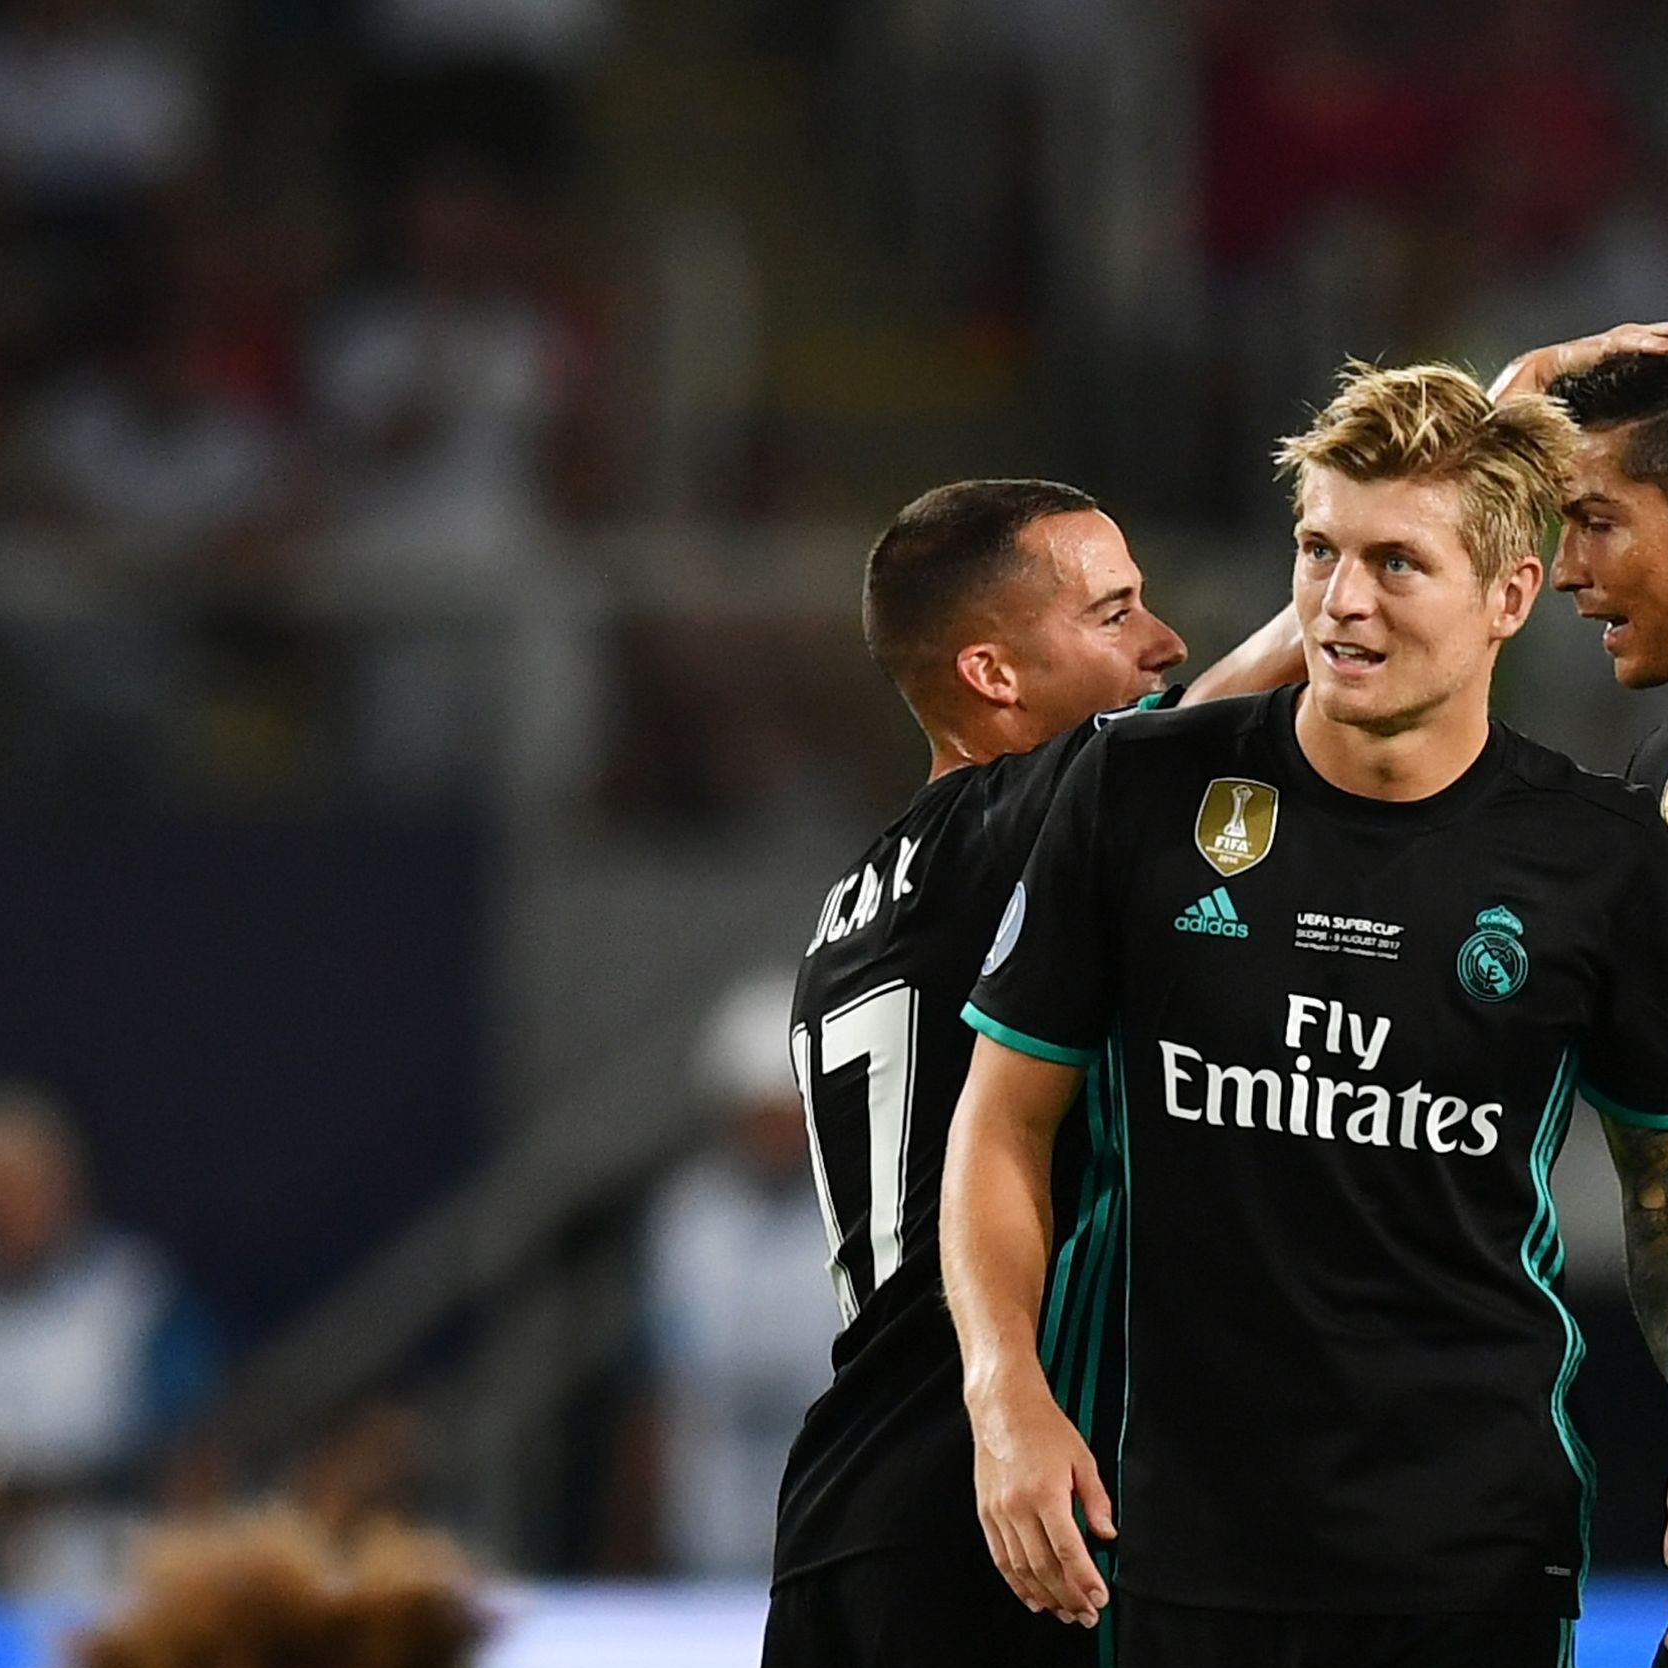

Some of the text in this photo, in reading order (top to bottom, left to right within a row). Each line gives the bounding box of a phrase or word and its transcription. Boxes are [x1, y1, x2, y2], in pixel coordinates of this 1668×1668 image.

[1214, 834, 1251, 853] FIFA
[1174, 914, 1250, 939] adidas
[1297, 912, 1331, 929] UEFA
[1331, 916, 1373, 934] SUPER
[1284, 992, 1392, 1072] Fly
[1157, 1039, 1504, 1157] Emirates
